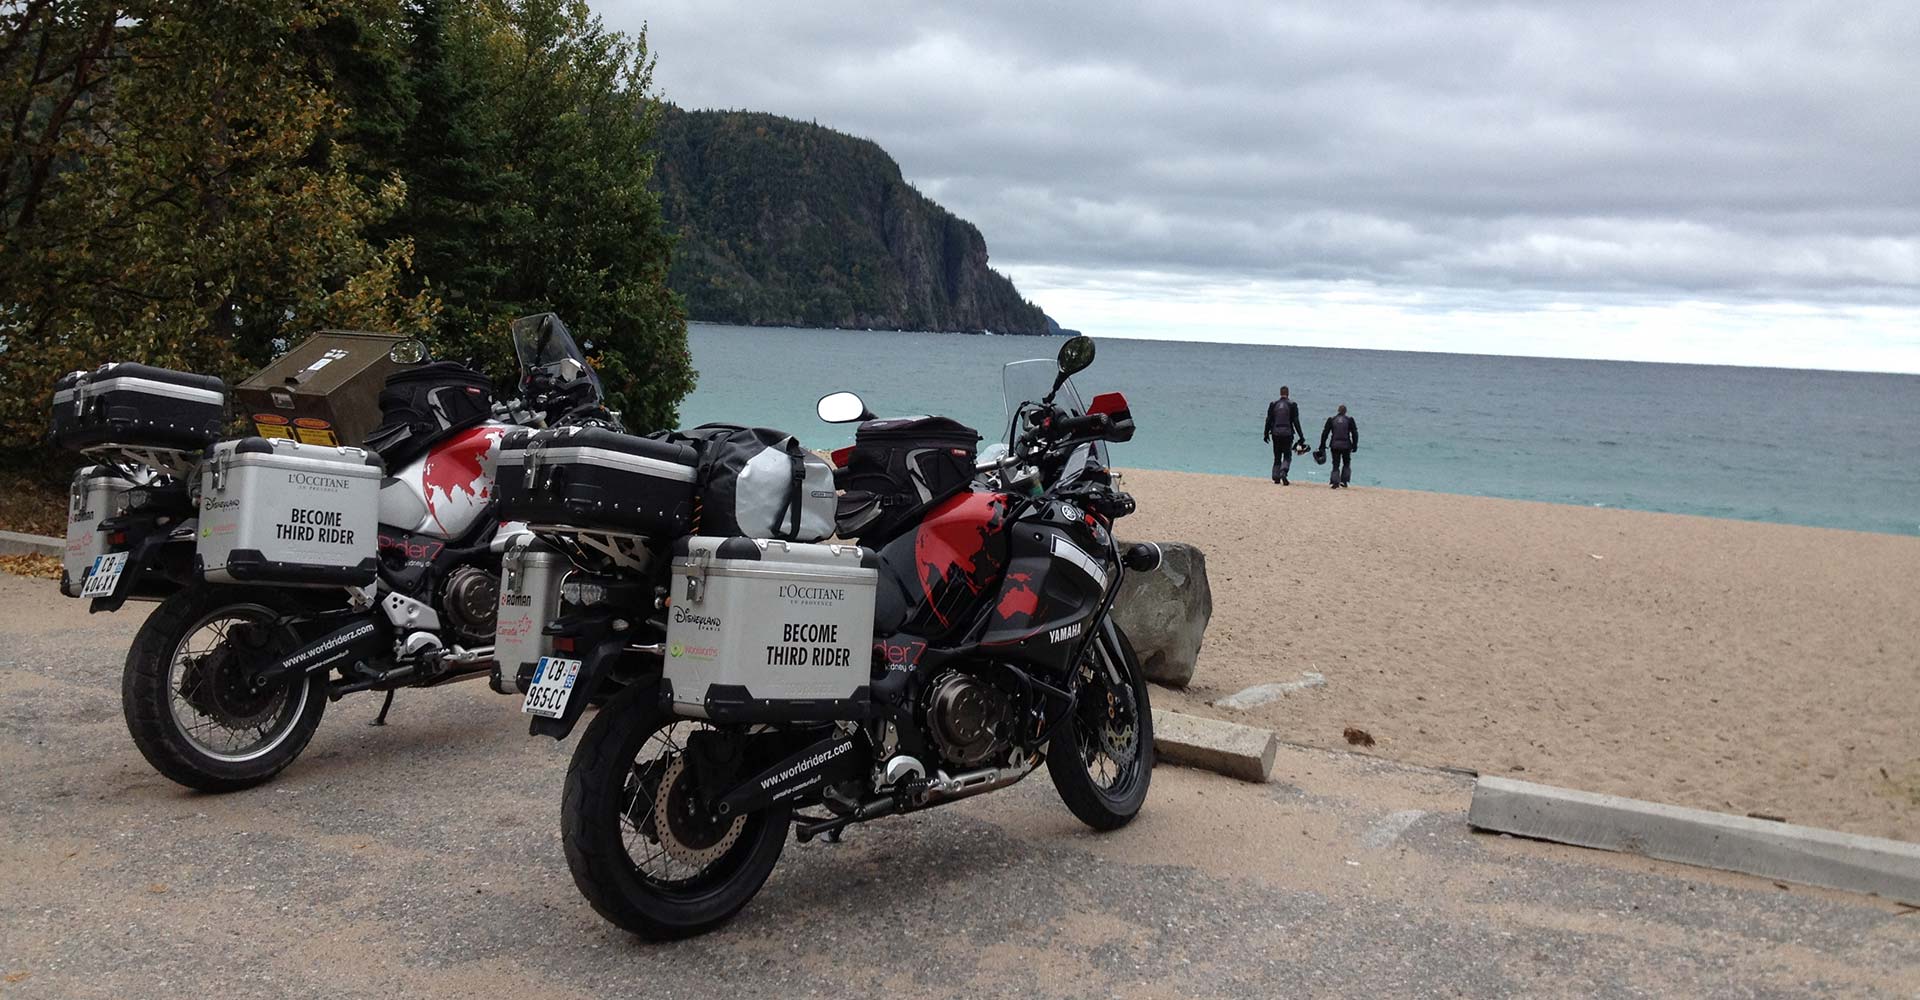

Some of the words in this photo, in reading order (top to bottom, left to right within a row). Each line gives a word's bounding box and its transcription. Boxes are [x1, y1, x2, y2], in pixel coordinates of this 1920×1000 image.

[288, 473, 350, 489] L'OCCITANE
[291, 508, 342, 527] BECOME
[276, 523, 315, 541] THIRD
[318, 527, 354, 545] RIDER
[506, 594, 532, 607] ROMAN
[779, 583, 845, 601] L'OCCITANE
[783, 623, 838, 643] BECOME
[1049, 622, 1082, 644] YAMAHA
[282, 623, 375, 669] www.worldriderz.com
[766, 646, 808, 666] THIRD
[811, 647, 850, 667] RIDER
[526, 685, 566, 711] 965-CC
